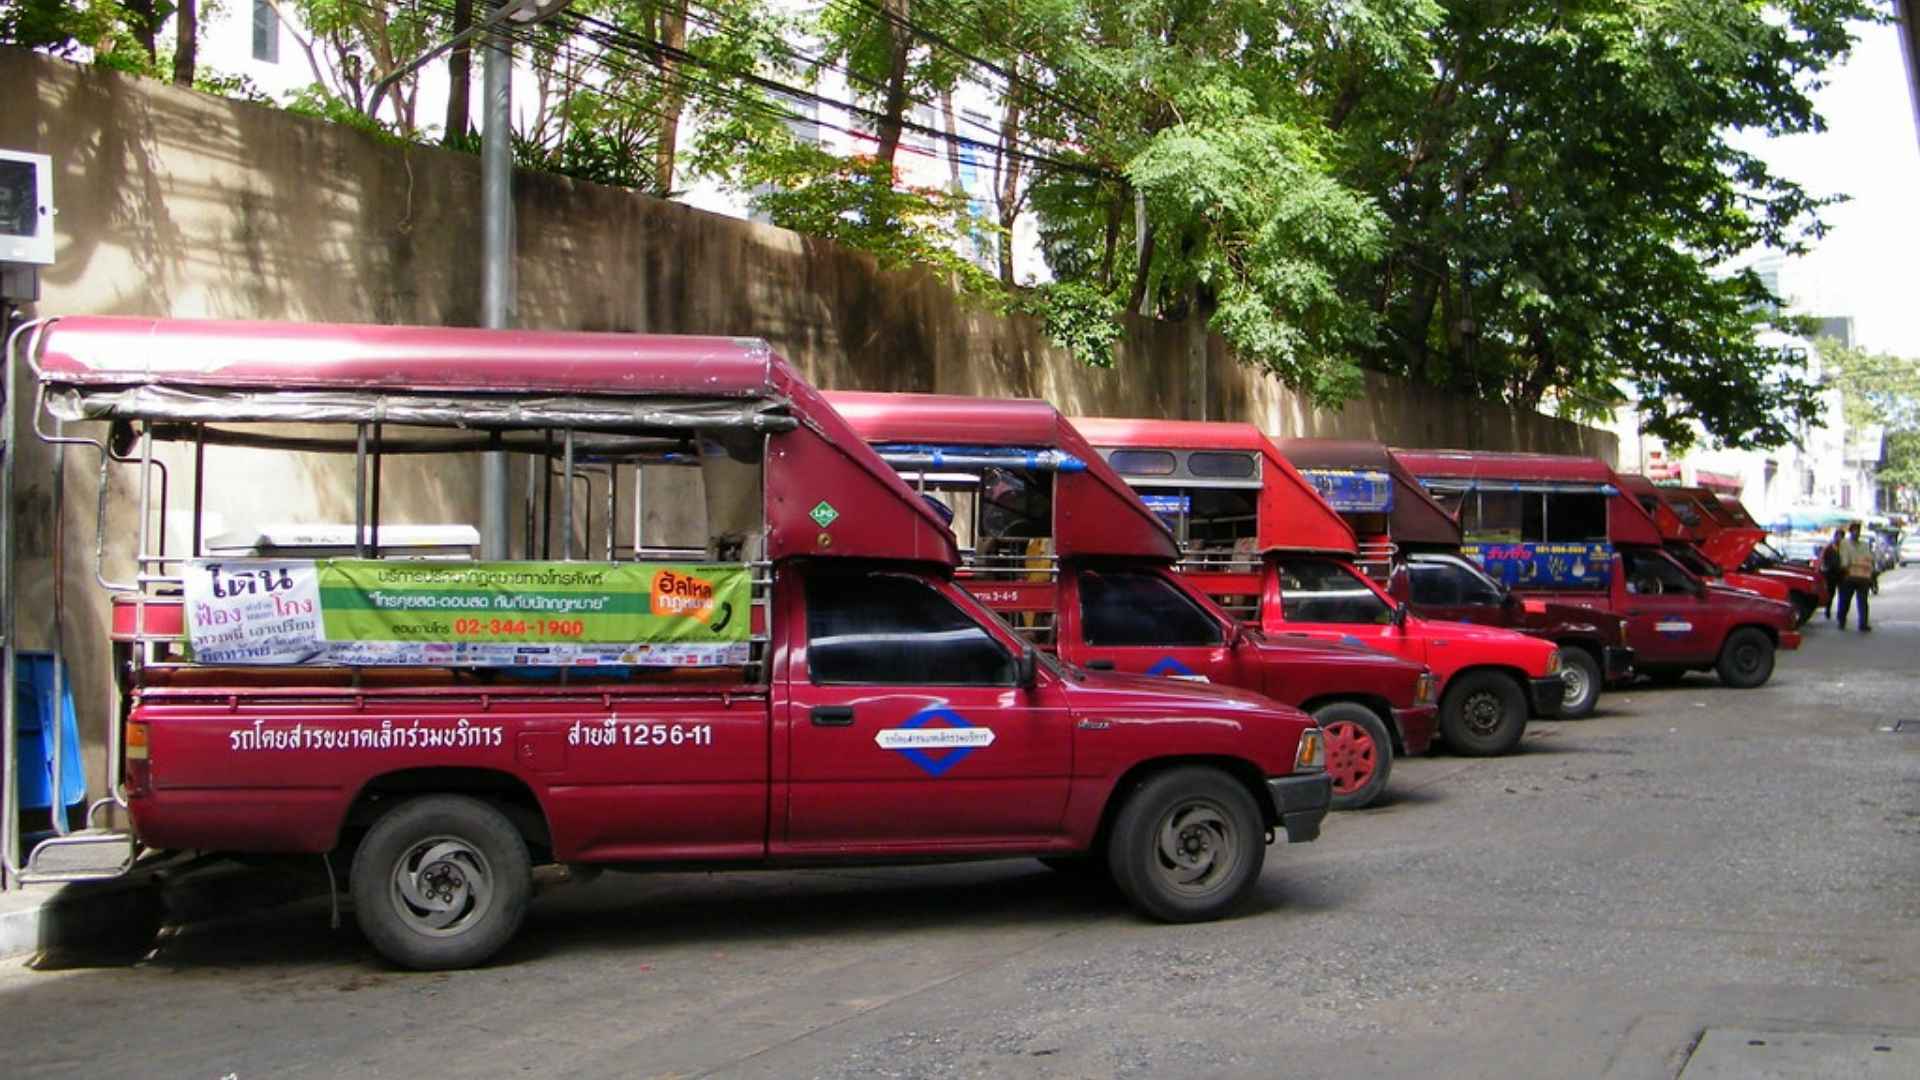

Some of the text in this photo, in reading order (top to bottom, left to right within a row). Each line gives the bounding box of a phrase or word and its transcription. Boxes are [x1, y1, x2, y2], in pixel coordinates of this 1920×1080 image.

[205, 564, 293, 598] โดน
[455, 618, 585, 637] 02-344-1900
[229, 718, 504, 751] รถโดยสารขนาดเล็กร่วมบริการ
[568, 711, 712, 746] สายที่ 1256-11
